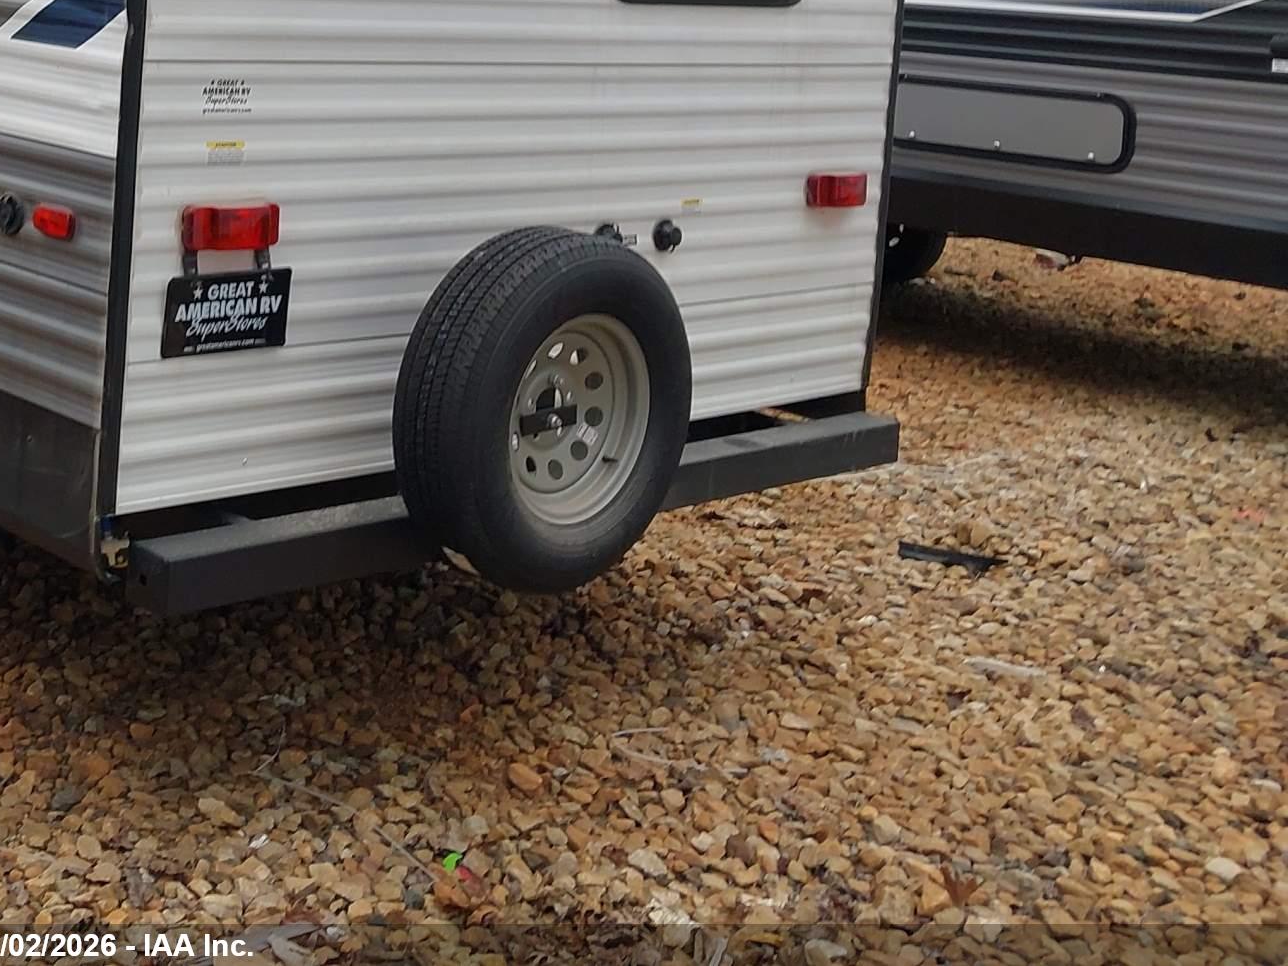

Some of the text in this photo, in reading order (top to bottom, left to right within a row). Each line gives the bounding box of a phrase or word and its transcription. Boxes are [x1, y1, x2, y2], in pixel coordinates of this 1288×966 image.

[207, 281, 255, 301] GREAT
[174, 294, 283, 323] AMERICAN RV
[185, 311, 269, 341] SuperStores
